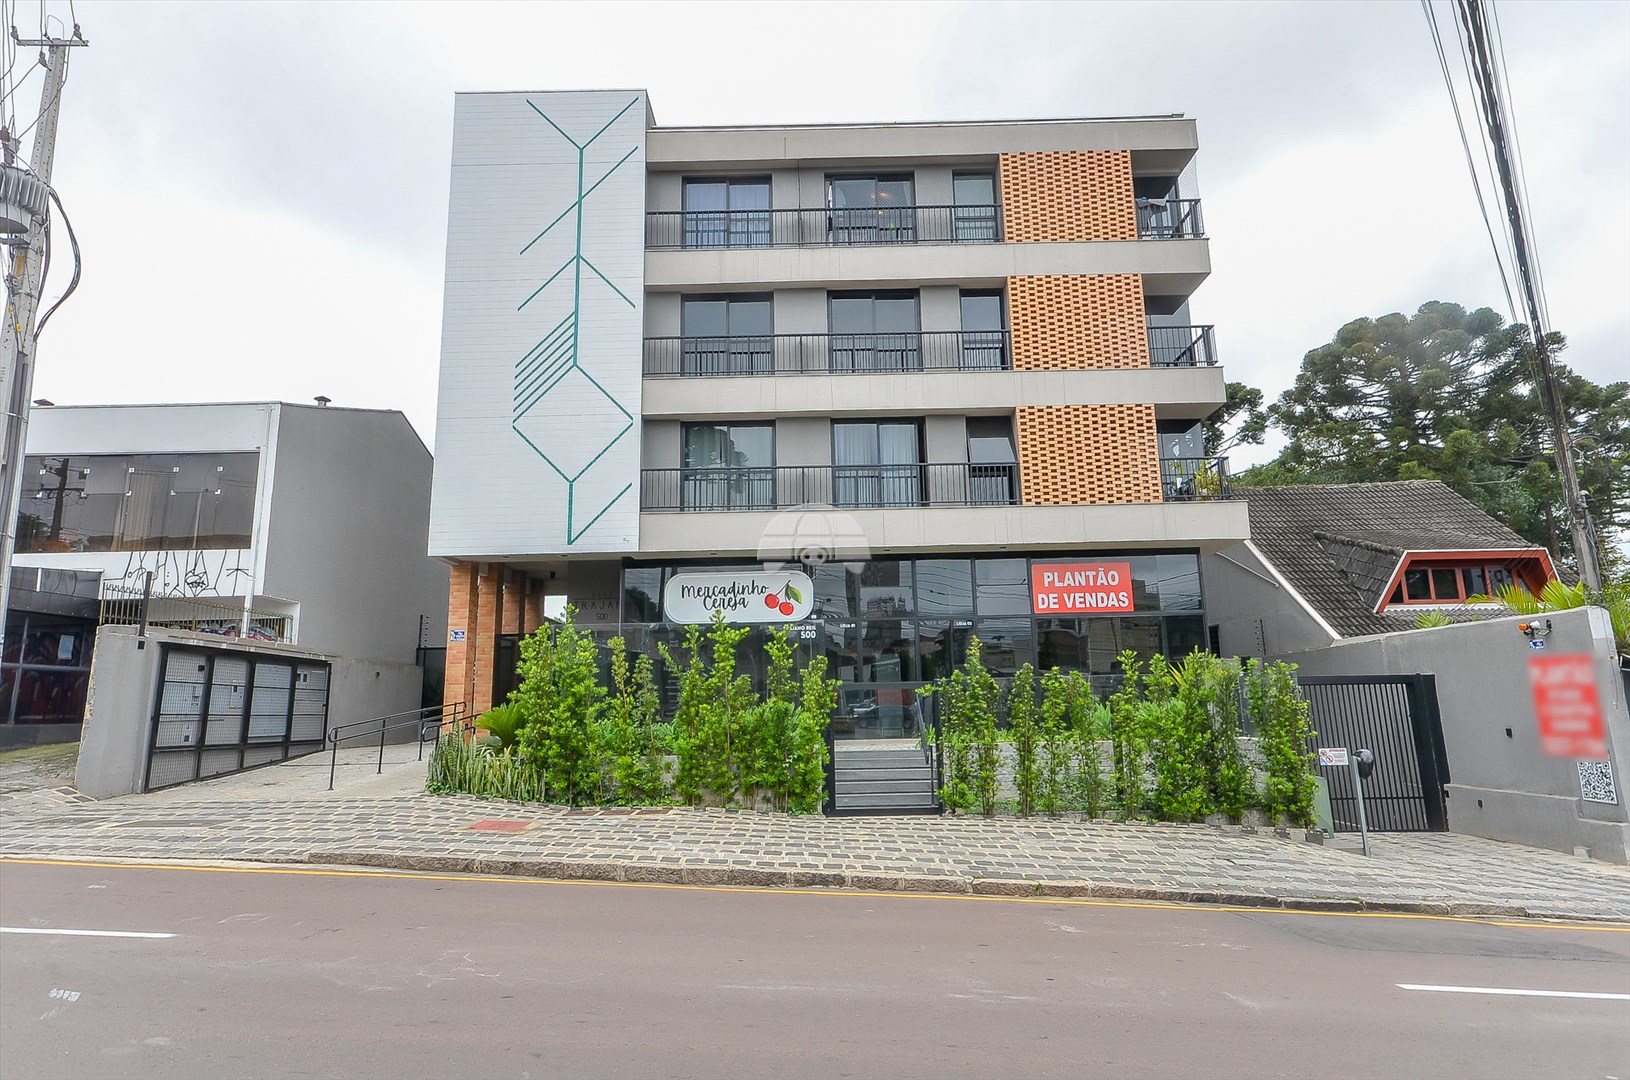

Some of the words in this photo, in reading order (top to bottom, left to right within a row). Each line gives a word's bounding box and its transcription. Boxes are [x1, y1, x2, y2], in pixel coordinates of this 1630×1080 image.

[1043, 567, 1119, 587] PLANTÃO
[681, 579, 769, 599] Mercadinho
[703, 596, 749, 611] Cereja
[1037, 593, 1059, 609] DE
[1063, 591, 1129, 608] VENDAS
